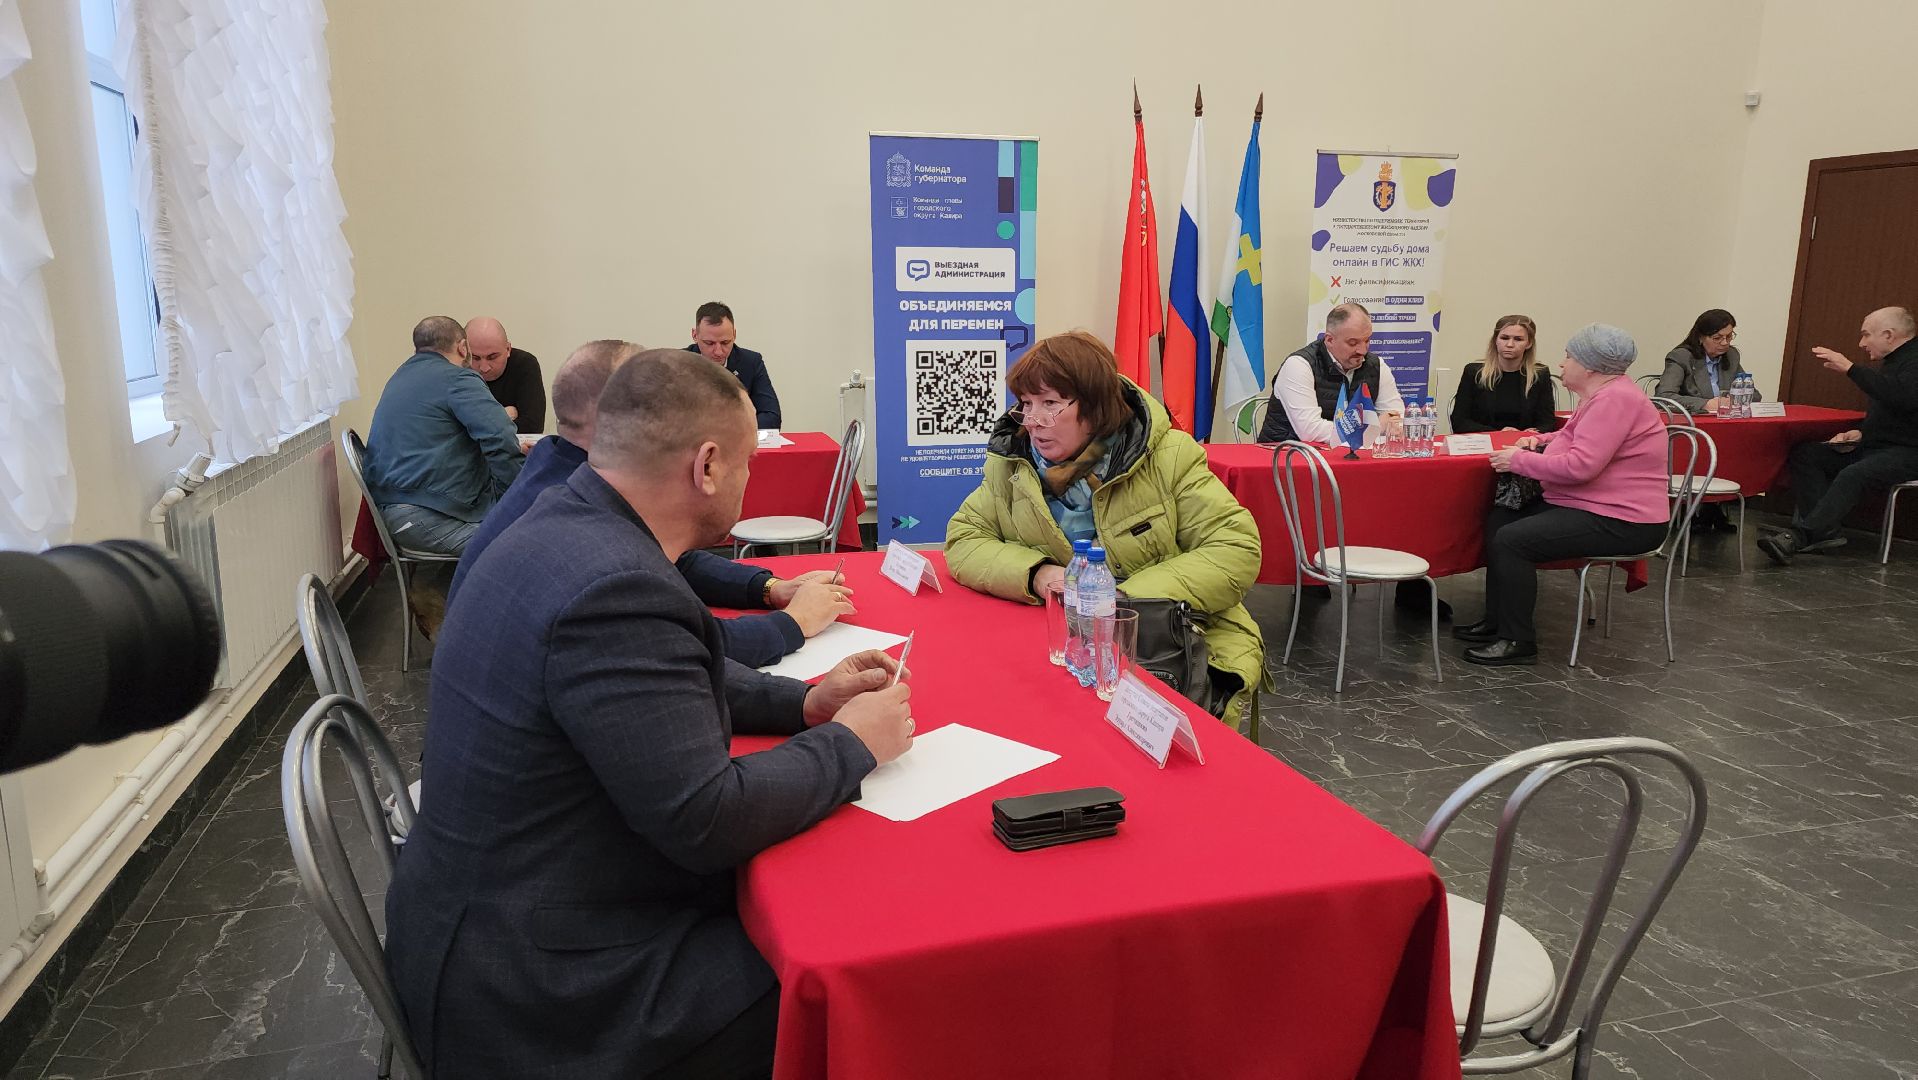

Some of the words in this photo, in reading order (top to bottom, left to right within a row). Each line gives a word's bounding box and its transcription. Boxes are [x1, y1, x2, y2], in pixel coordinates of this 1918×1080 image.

[914, 163, 951, 174] Команда
[914, 174, 967, 184] губернатора
[1330, 243, 1368, 253] Решаем
[1370, 244, 1404, 254] судьбу
[1406, 245, 1430, 253] дома
[934, 261, 979, 269] ВЫЕЗДНАЯ
[1332, 257, 1369, 267] онлайн
[1380, 258, 1399, 266] ГИС
[1402, 258, 1425, 267] ЖКХ!
[934, 270, 1006, 279] АДМИНИСТРАЦИЯ
[899, 300, 1012, 313] ОБЪЕДИНЯЕМСЯ
[908, 319, 939, 332] ДЛЯ
[941, 318, 1005, 331] ПЕРЕМЕН
[919, 467, 962, 477] СООБЩИТЕ
[962, 467, 973, 476] ОБ
[974, 467, 985, 475] ЭТ
